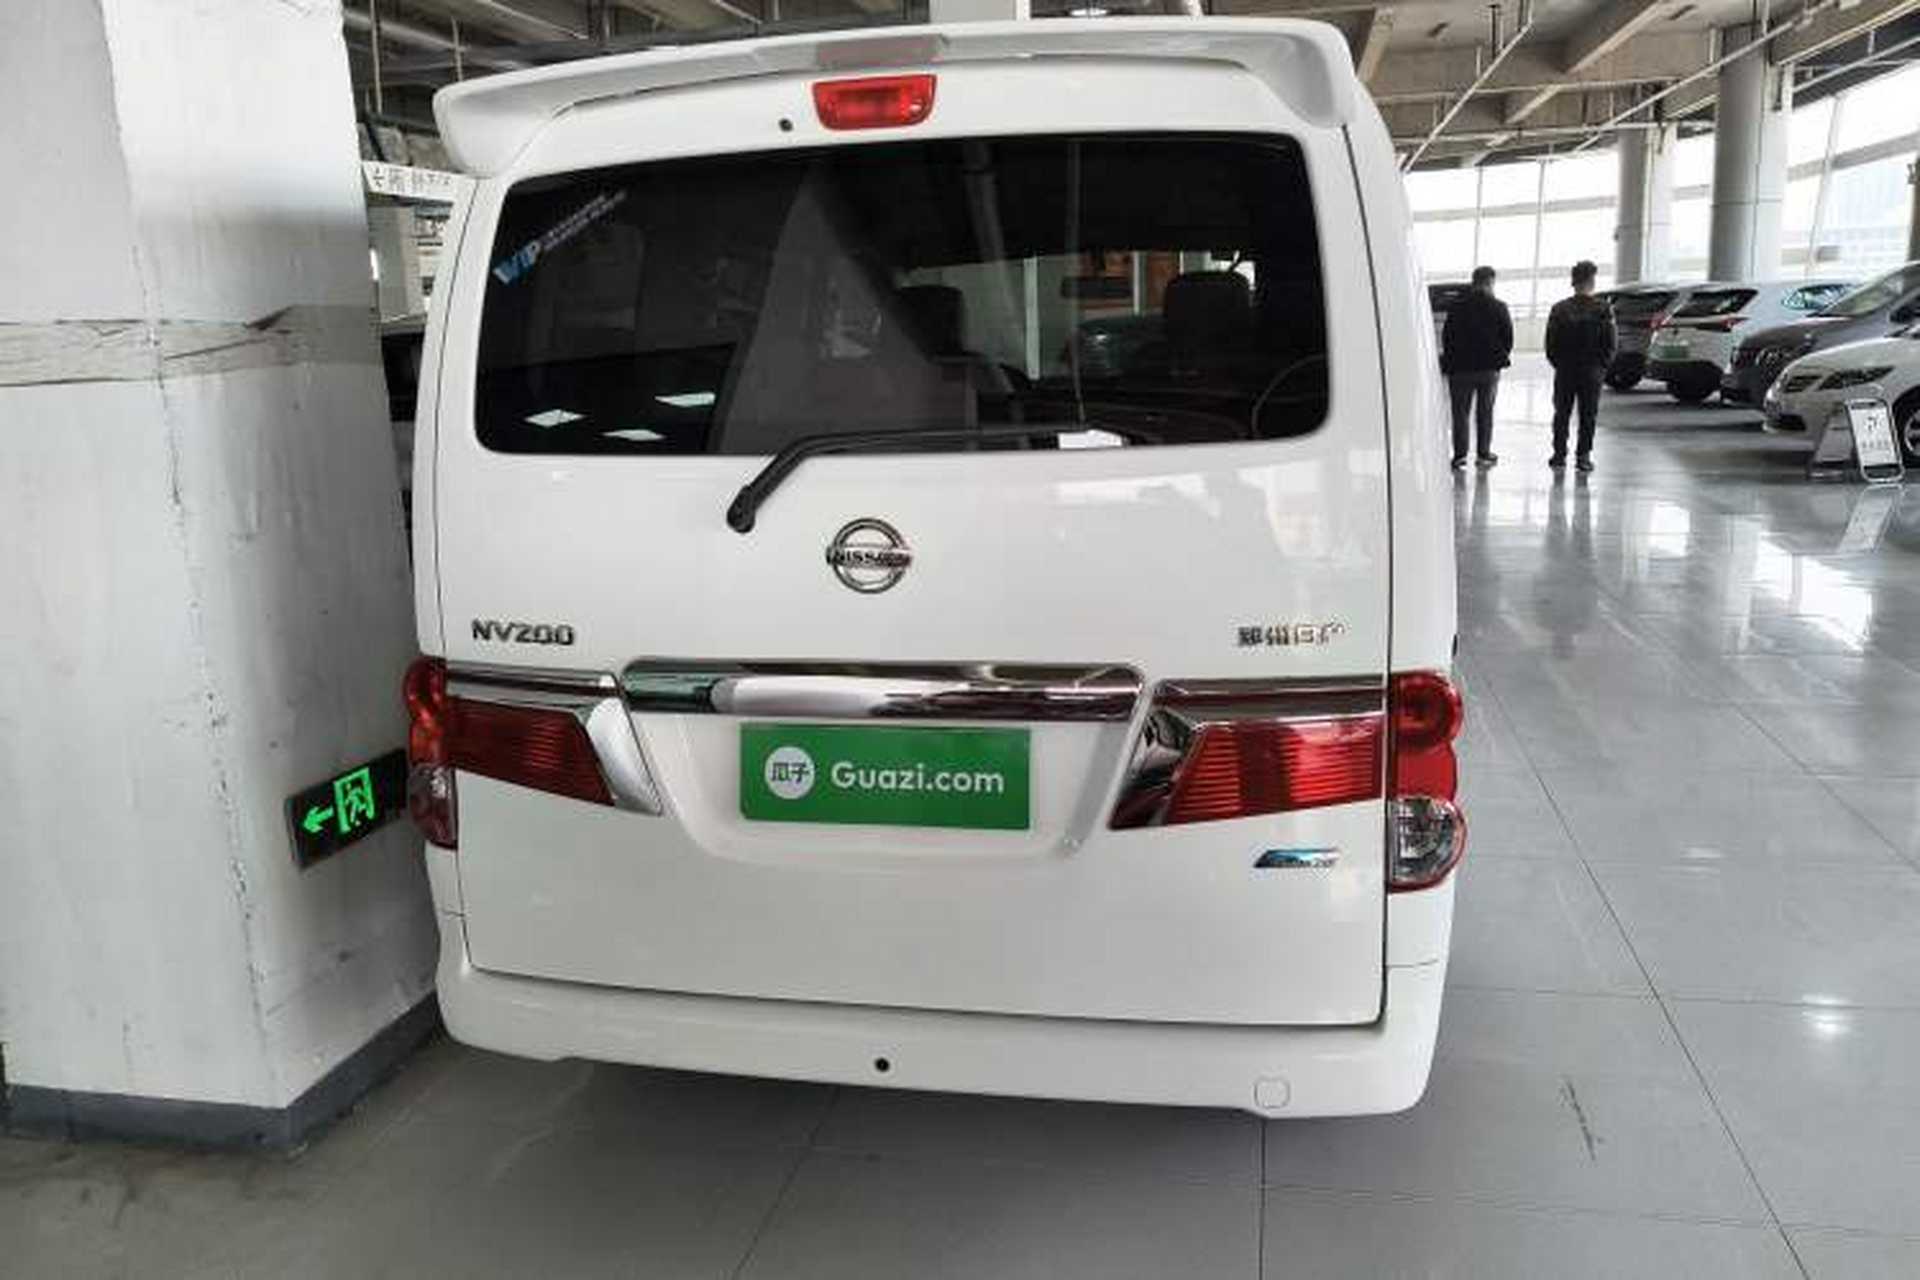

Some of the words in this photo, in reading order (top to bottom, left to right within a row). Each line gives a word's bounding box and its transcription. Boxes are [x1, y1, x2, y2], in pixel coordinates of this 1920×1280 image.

[471, 618, 574, 646] NV200
[771, 762, 810, 784] 瓜子
[830, 761, 1005, 793] Guazi.com
